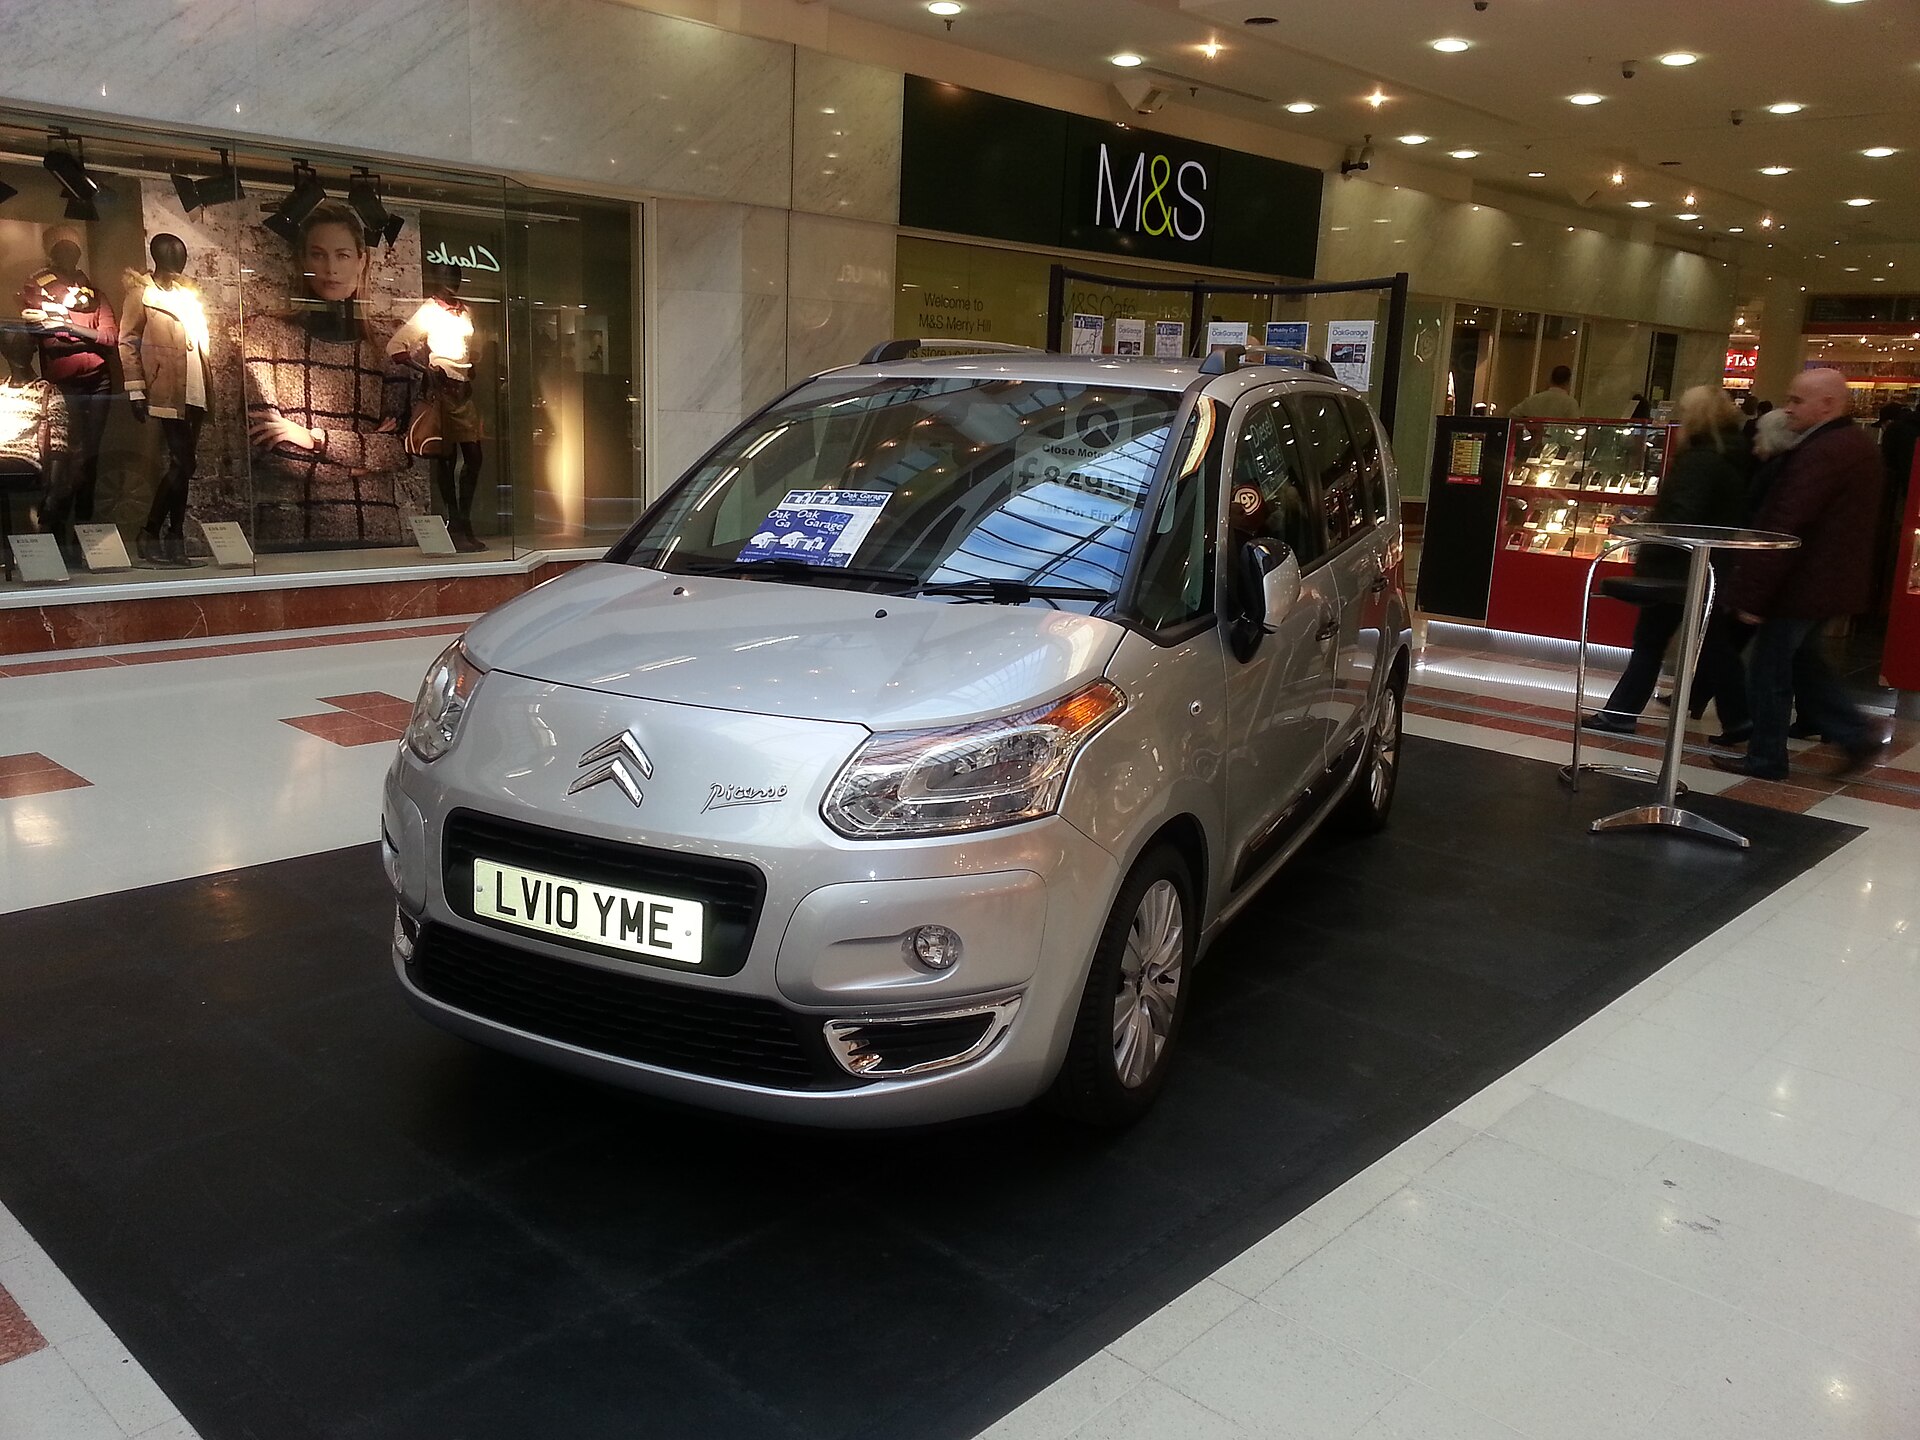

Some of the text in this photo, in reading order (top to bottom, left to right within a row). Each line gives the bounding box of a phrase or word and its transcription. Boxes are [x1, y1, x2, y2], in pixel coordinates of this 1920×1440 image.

[1095, 143, 1207, 241] M&S
[924, 292, 984, 312] Welcome to
[1100, 294, 1136, 322] Café
[918, 313, 992, 335] M&S Merry Hill
[1211, 329, 1244, 338] OakGarage
[1332, 328, 1369, 338] OakGarage
[1042, 443, 1076, 456] Close
[859, 492, 887, 501] Garage
[767, 510, 792, 520] Oak
[796, 510, 820, 520] Oak
[804, 518, 844, 532] Garage
[701, 782, 788, 814] Picasso
[496, 870, 674, 950] LV10 YME
